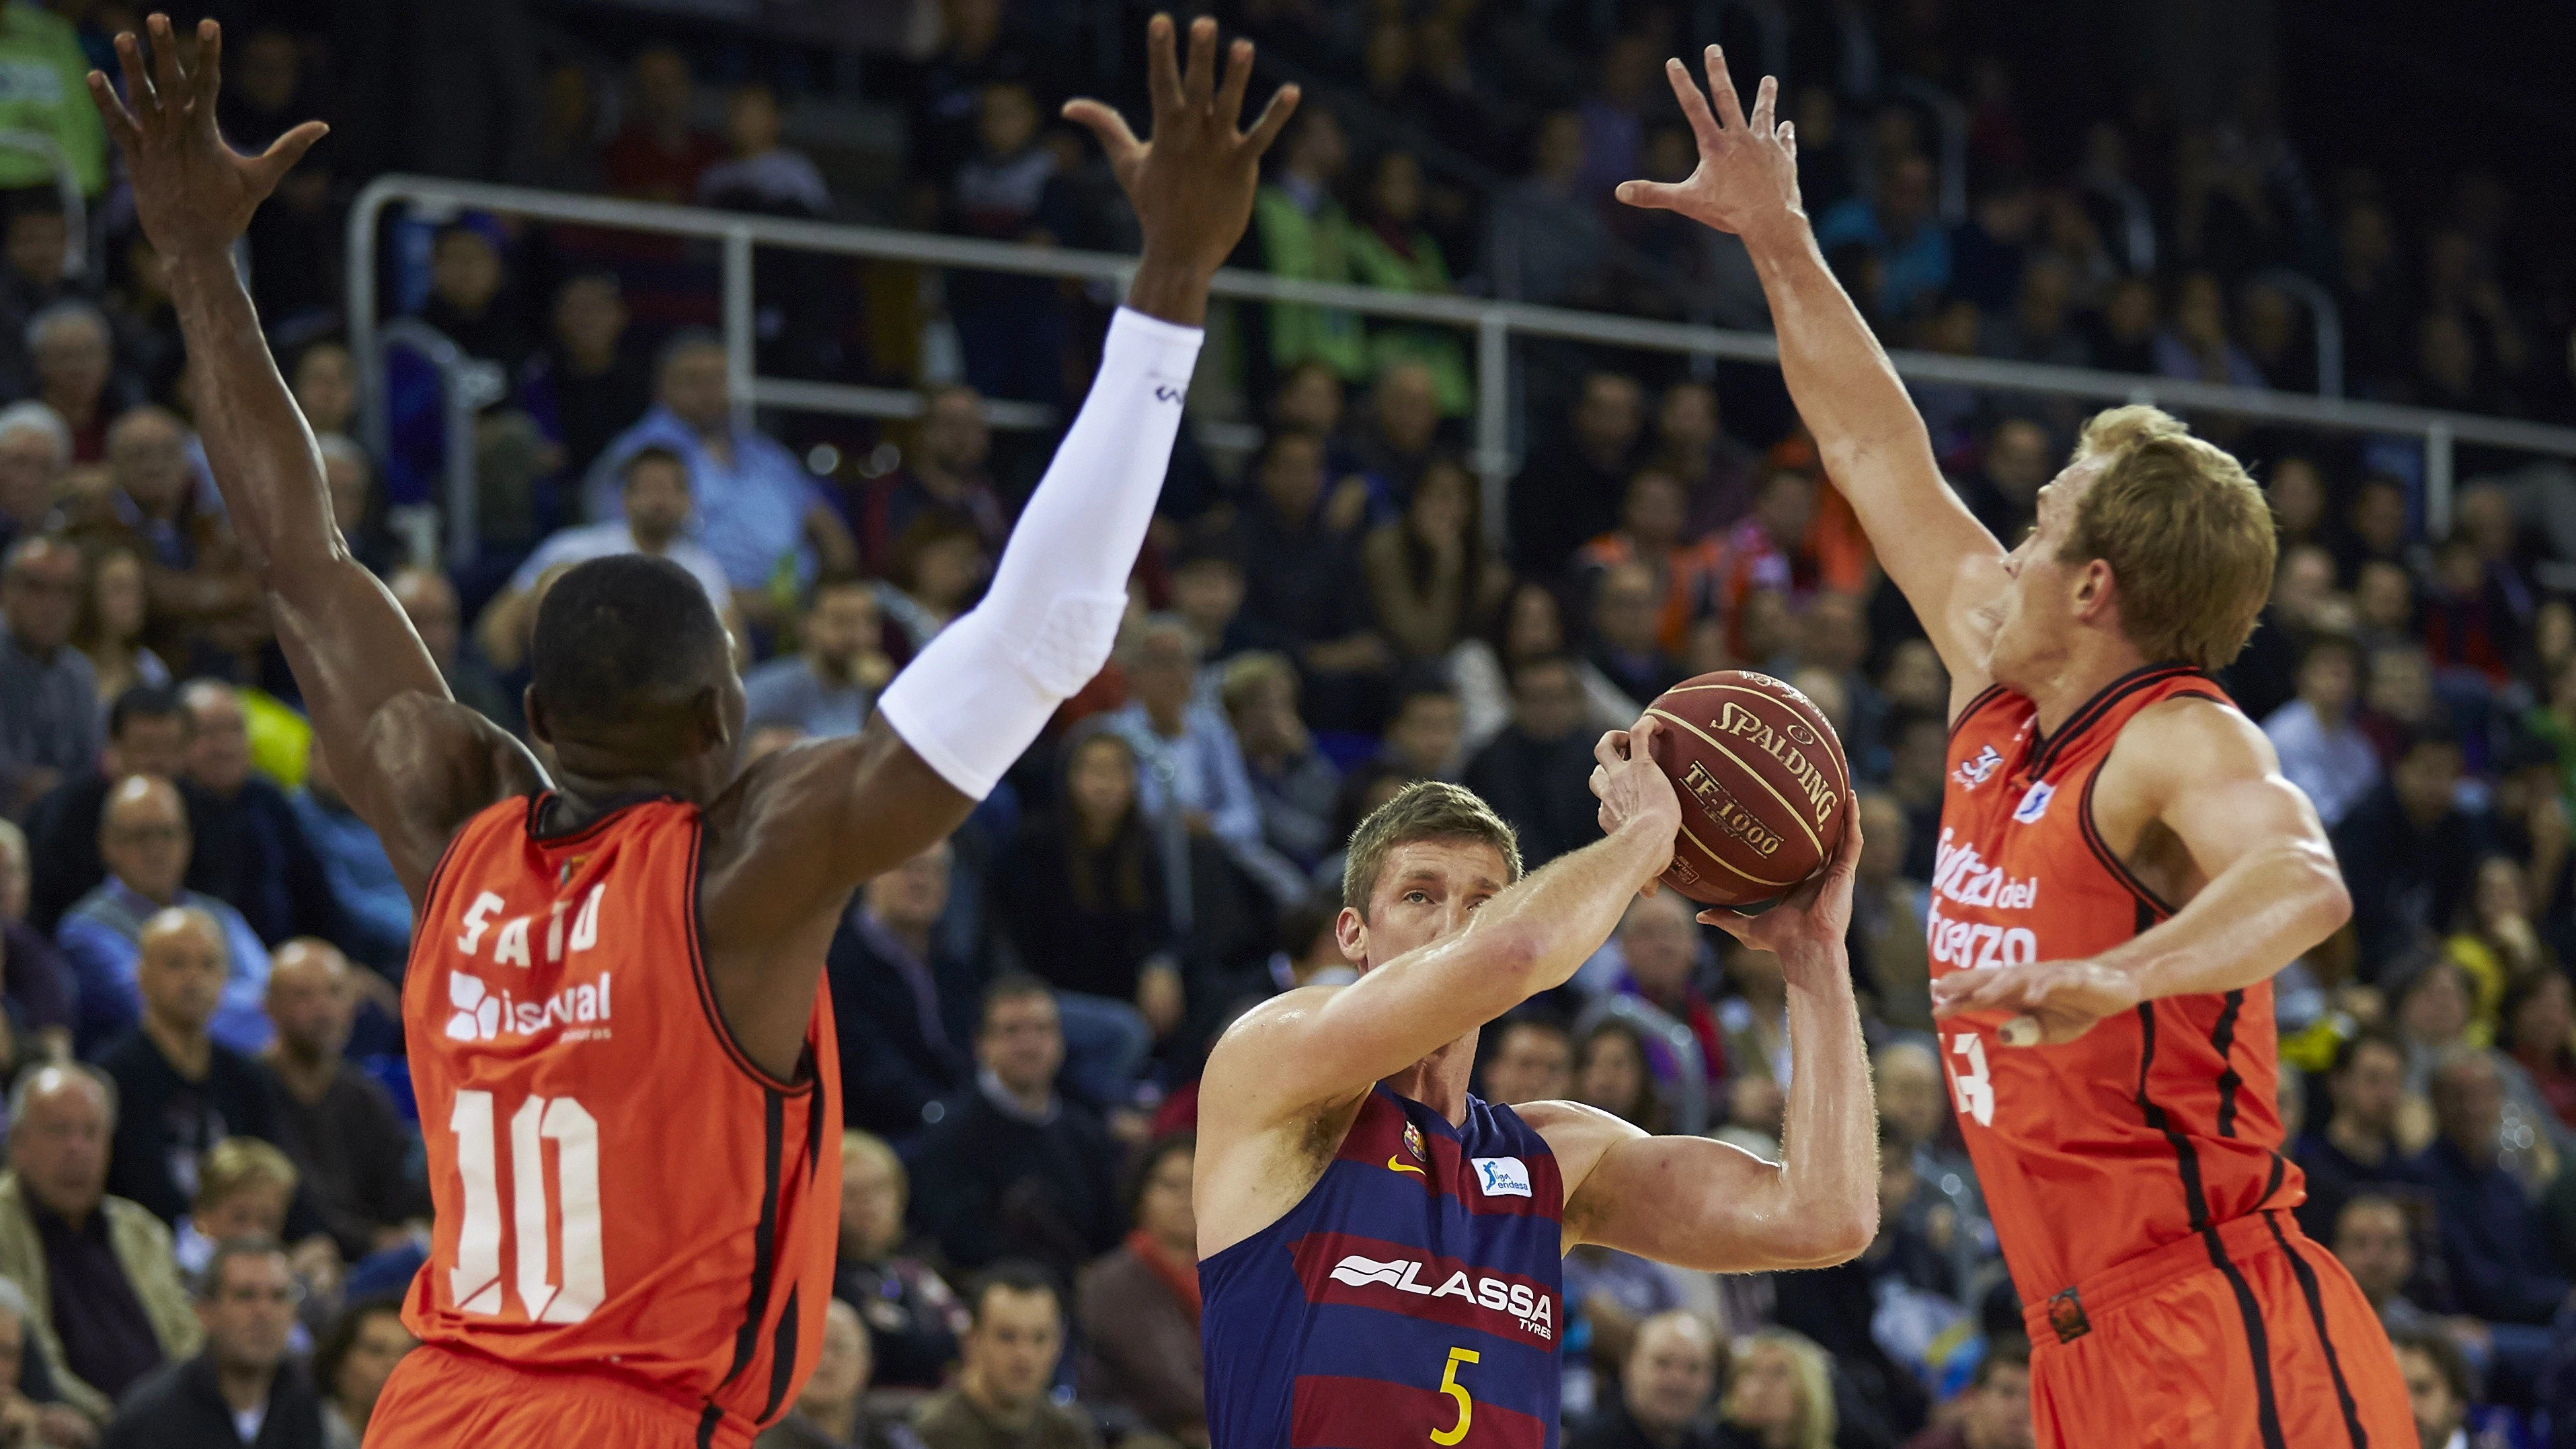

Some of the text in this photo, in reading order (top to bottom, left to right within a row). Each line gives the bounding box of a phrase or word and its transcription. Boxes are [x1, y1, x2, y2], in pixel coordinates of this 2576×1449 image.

[1709, 701, 1838, 825] SPALDING
[1684, 763, 1779, 855] TF-1000
[457, 883, 606, 969] SATO
[1996, 876, 2038, 909] del
[449, 1089, 607, 1323] 10
[1493, 1169, 1512, 1182] liga
[1497, 1180, 1528, 1191] endesa
[1397, 1261, 1552, 1329] LASSA
[1519, 1318, 1551, 1341] TYRES
[1430, 1346, 1480, 1447] 5
